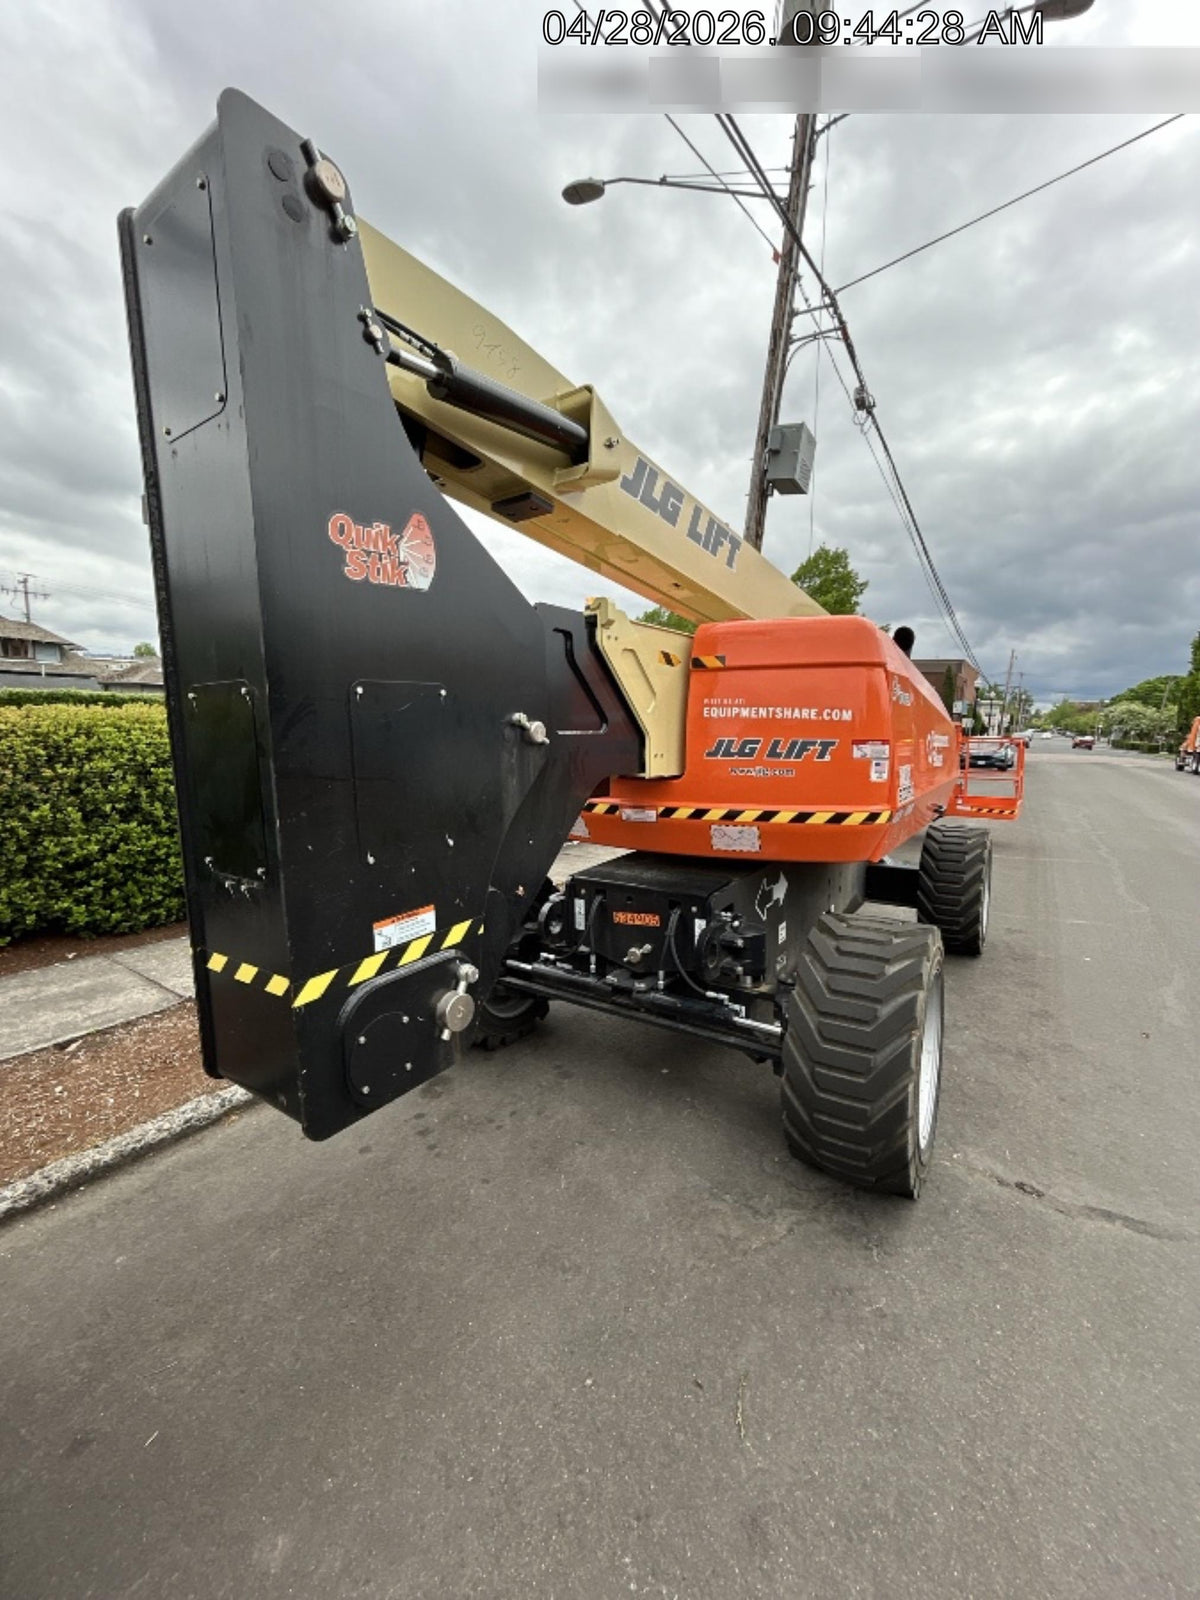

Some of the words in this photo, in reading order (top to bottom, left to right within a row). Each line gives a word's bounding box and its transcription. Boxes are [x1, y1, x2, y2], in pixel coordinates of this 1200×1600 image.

[620, 456, 685, 528] JLG
[686, 503, 742, 570] LIFT
[328, 513, 401, 555] Quik
[344, 549, 409, 587] Stik
[703, 706, 853, 721] EQUIPMENTSHARE.COM
[704, 737, 763, 760] JLG
[764, 738, 839, 761] LIFT
